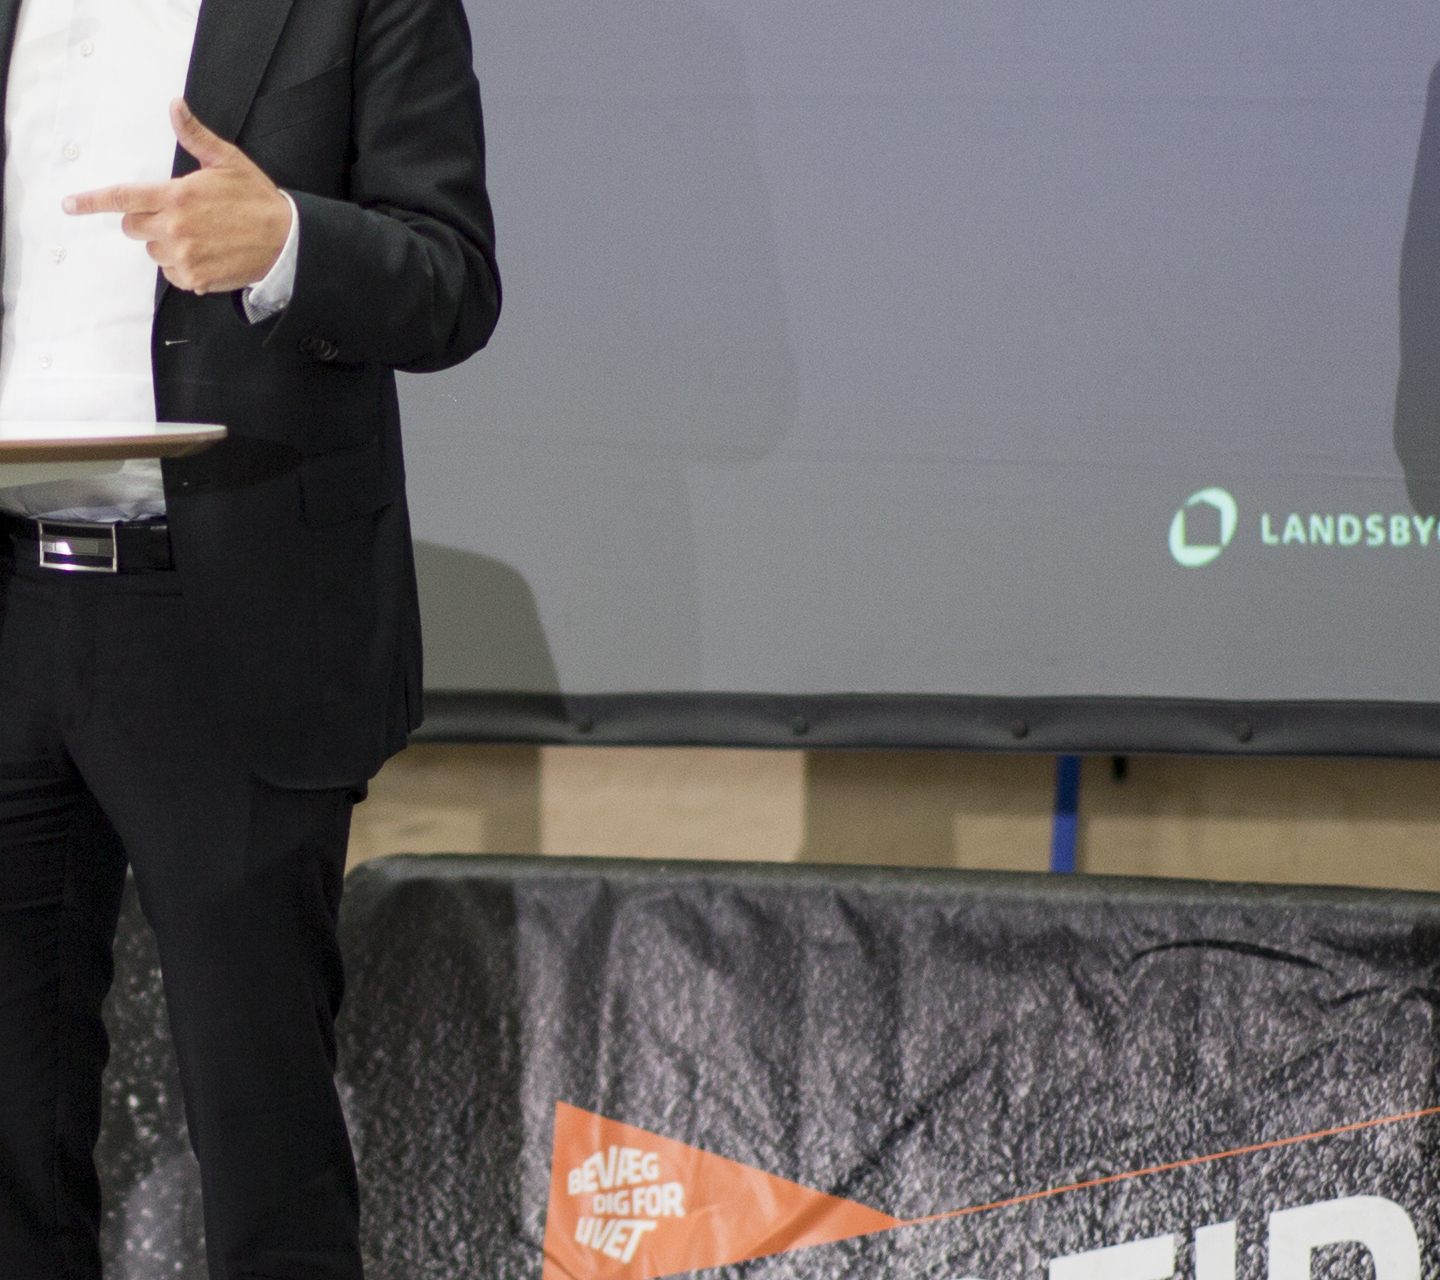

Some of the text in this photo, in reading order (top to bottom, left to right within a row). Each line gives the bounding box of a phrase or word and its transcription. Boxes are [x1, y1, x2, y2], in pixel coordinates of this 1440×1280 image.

[567, 1145, 660, 1196] BEVÆG
[593, 1182, 686, 1218] DIG FOR
